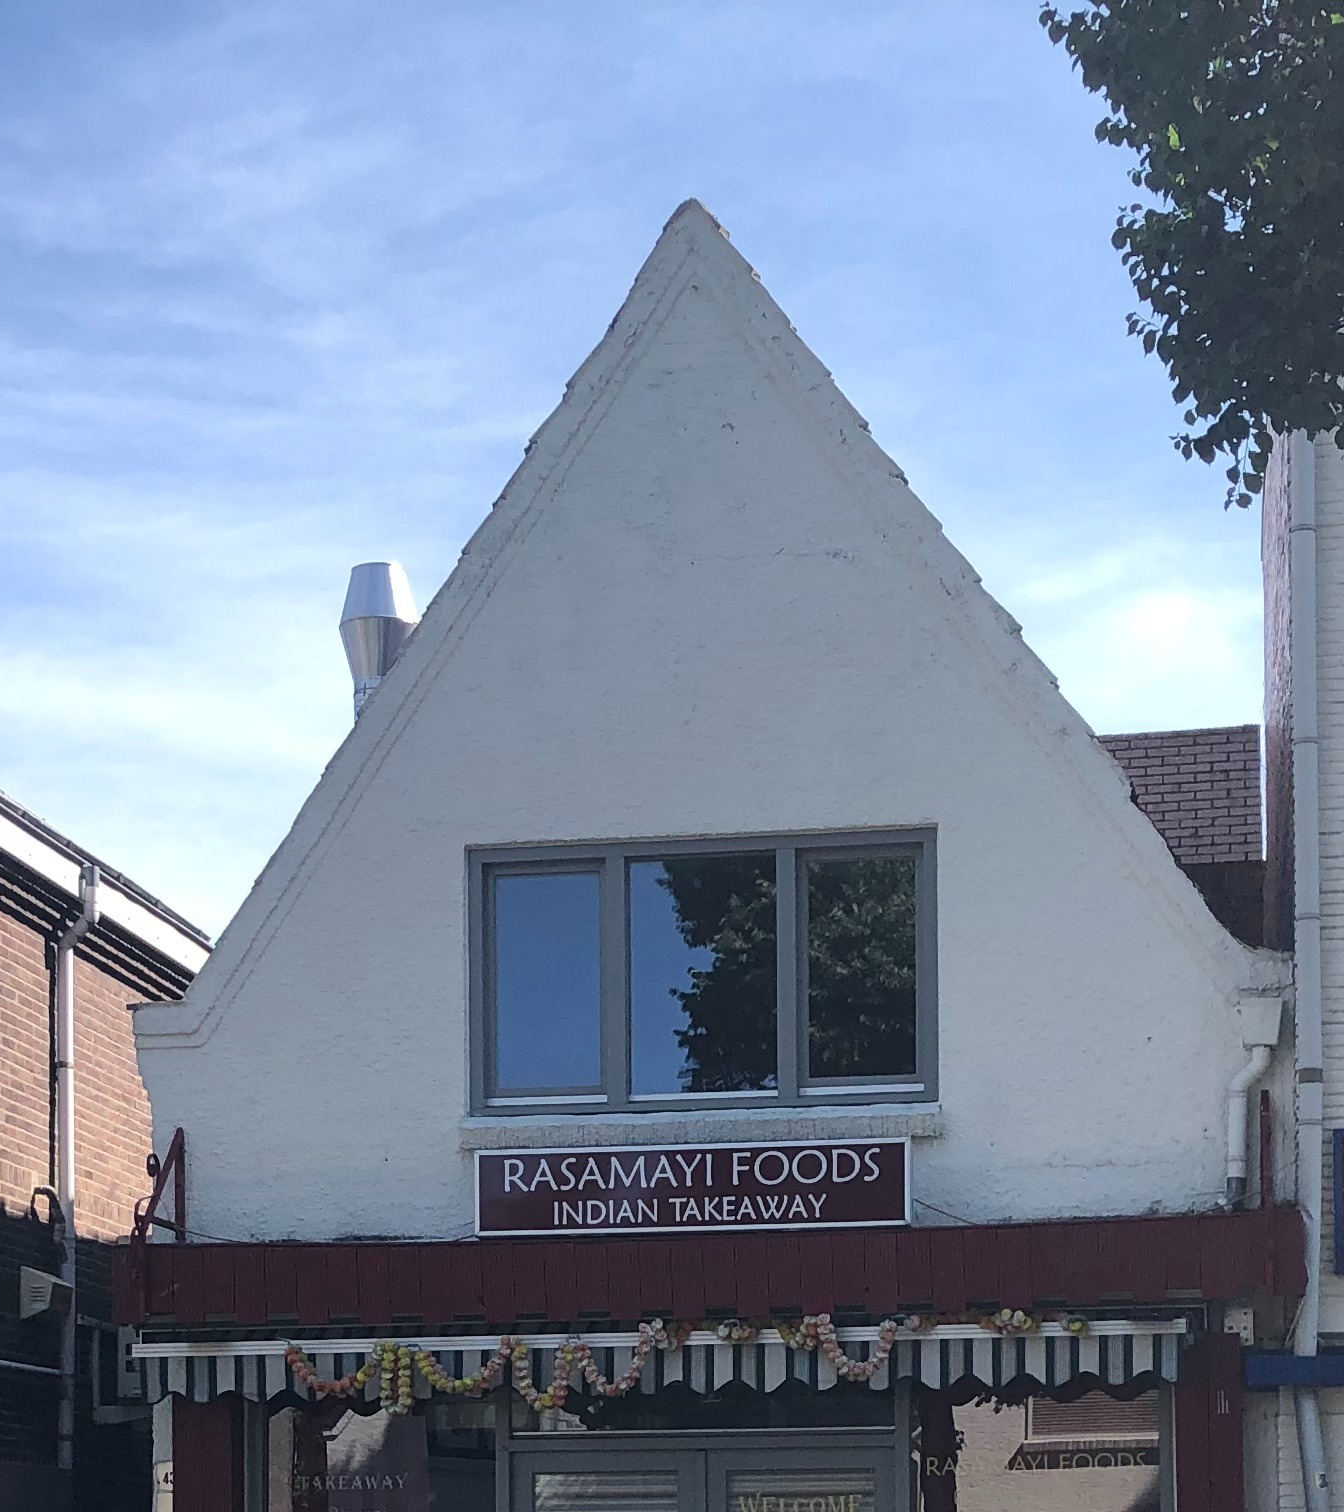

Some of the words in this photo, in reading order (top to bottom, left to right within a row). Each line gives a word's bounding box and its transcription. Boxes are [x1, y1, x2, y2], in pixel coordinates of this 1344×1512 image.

[503, 1153, 713, 1193] RASAMAYI
[731, 1147, 881, 1186] FOODS
[553, 1199, 658, 1226] INDIAN
[668, 1193, 827, 1222] TAKEAWAY
[300, 1473, 408, 1490] TAKEAWAY
